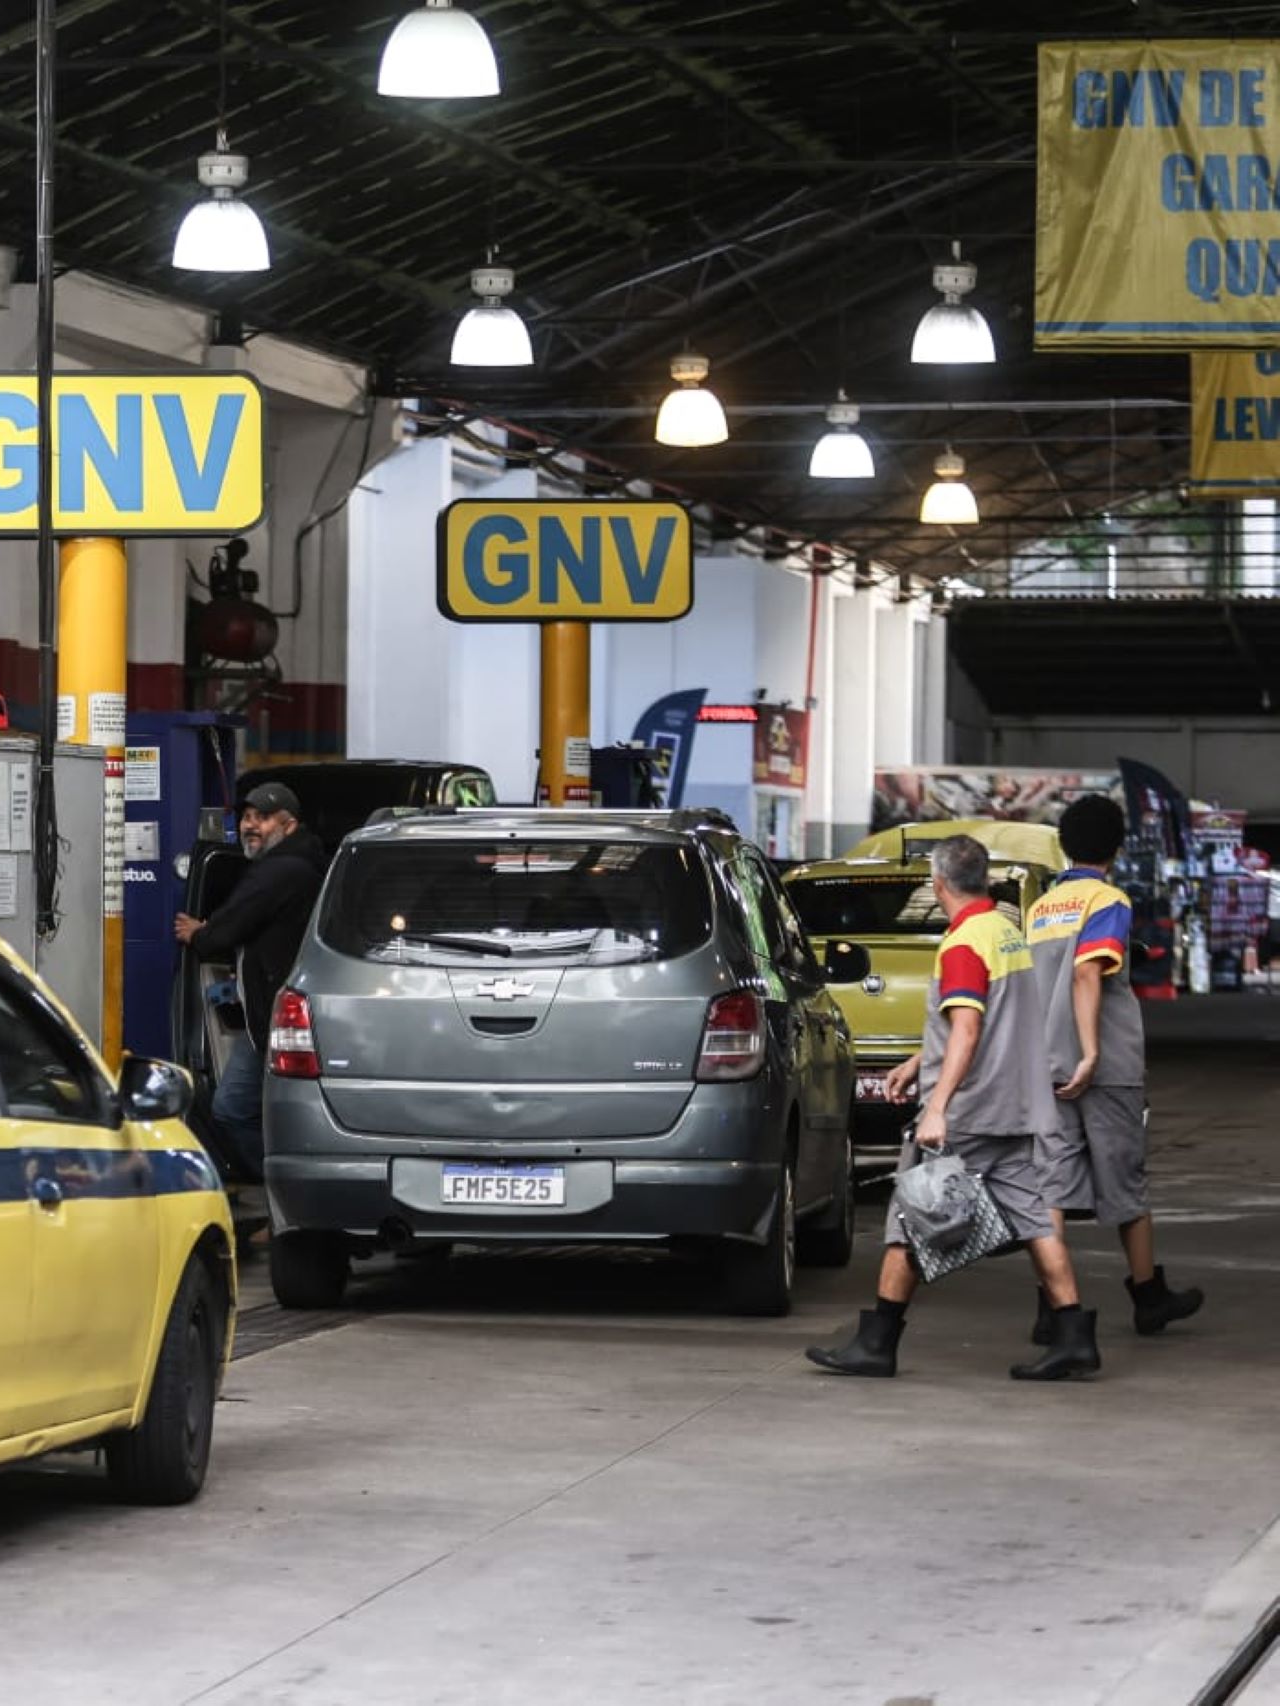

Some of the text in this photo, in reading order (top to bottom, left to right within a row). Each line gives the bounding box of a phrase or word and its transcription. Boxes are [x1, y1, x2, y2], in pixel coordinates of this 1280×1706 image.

[1073, 69, 1266, 128] GNV DE
[1160, 153, 1280, 214] GAR
[1214, 396, 1280, 442] LEV
[462, 513, 679, 606] GNV
[451, 1177, 553, 1200] FMF5E25
